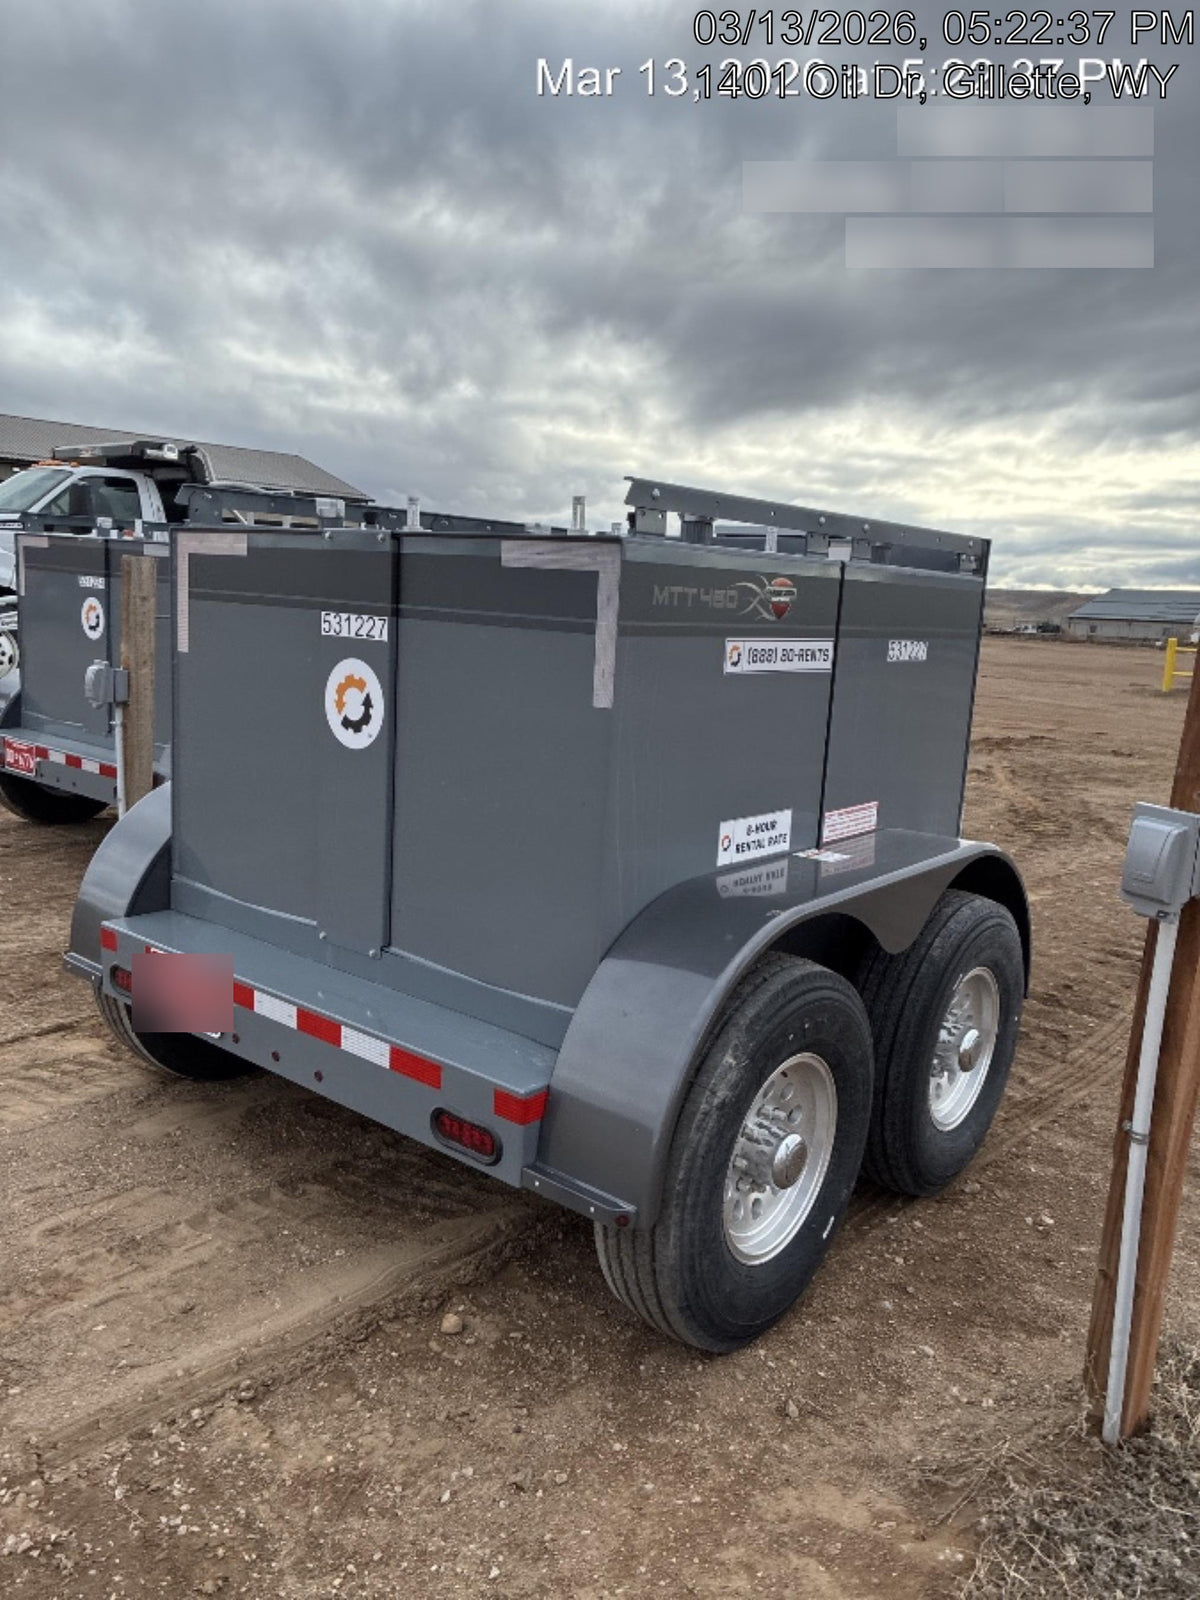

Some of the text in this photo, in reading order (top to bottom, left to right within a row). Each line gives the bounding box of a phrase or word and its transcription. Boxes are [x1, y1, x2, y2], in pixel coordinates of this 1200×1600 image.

[652, 584, 698, 607] MTT
[322, 612, 387, 639] 531227
[735, 833, 788, 853] RENTAL RATE
